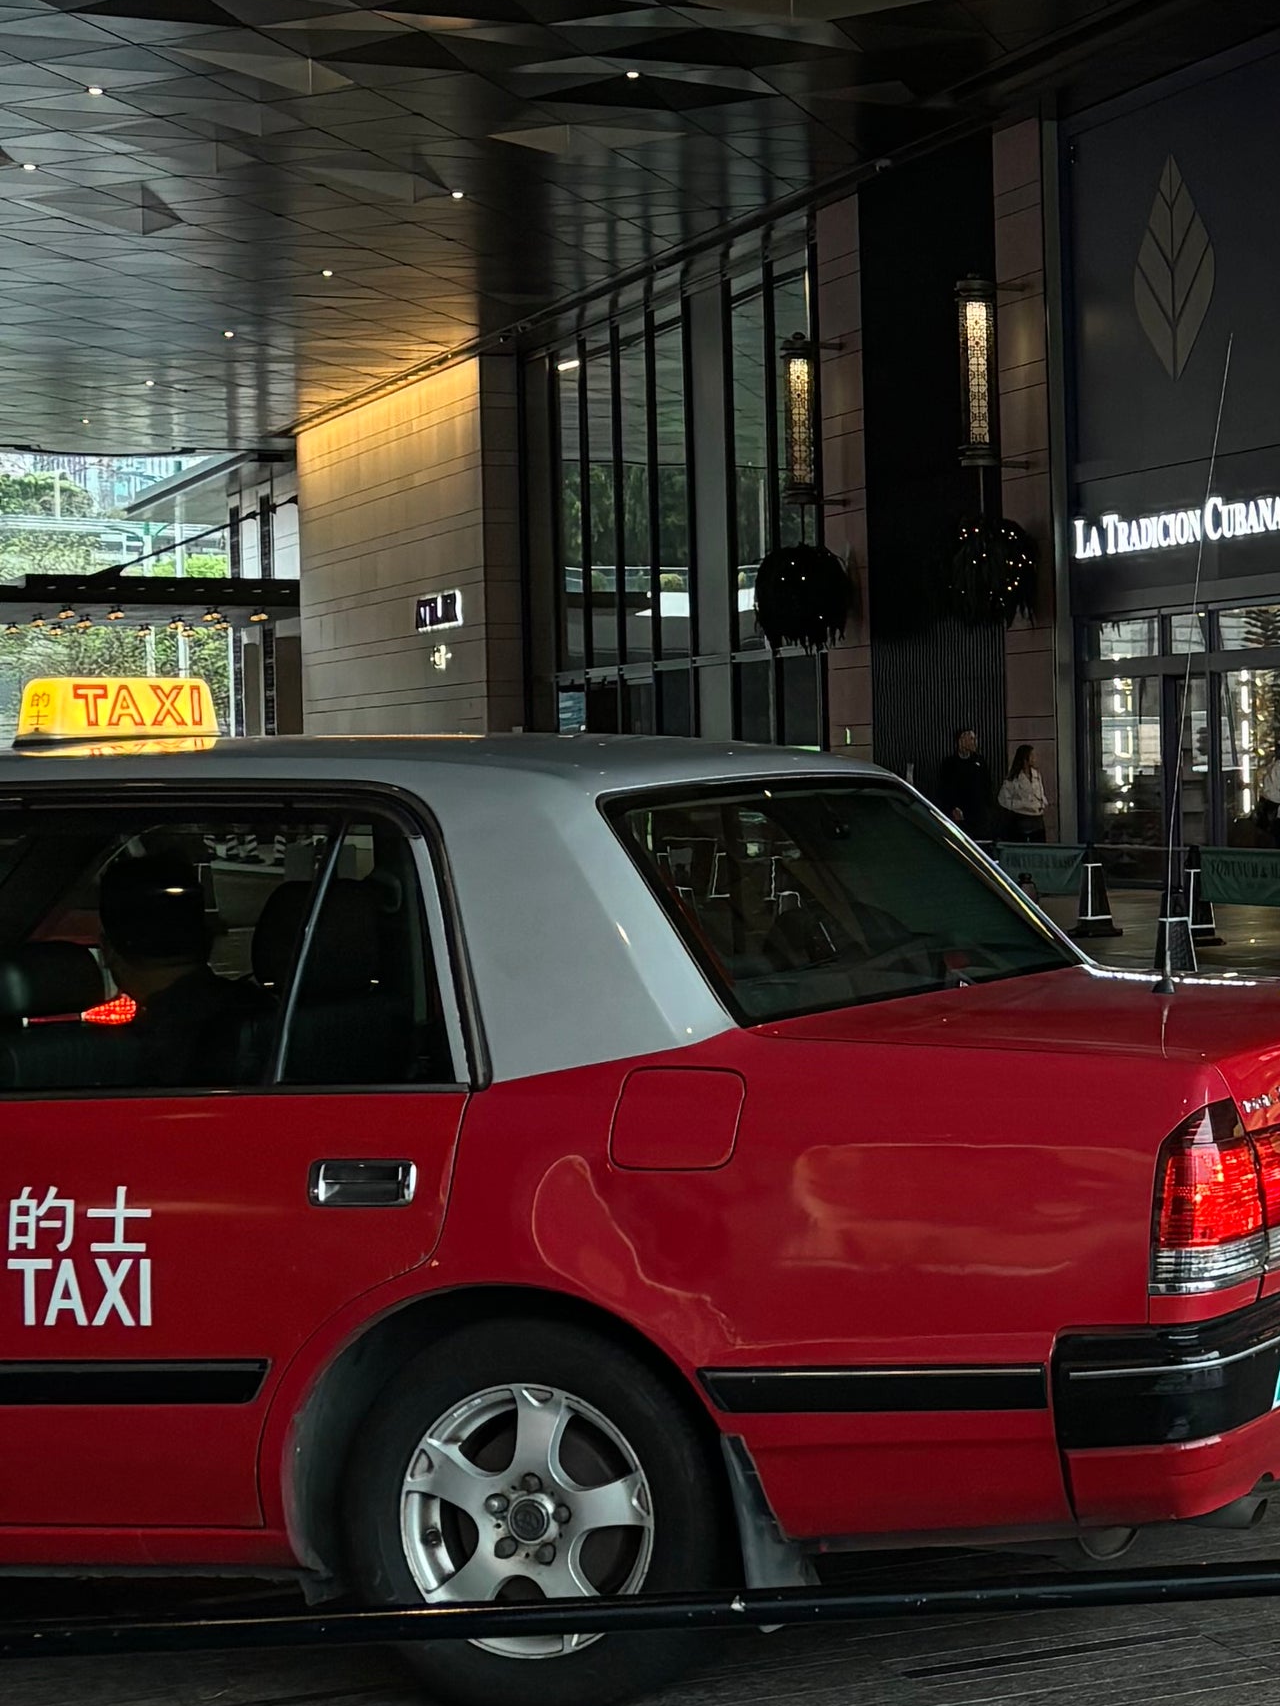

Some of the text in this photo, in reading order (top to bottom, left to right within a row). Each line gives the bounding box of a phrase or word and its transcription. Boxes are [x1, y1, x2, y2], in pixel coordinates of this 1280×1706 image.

[29, 692, 50, 726] 的士
[72, 684, 204, 727] TAXI
[8, 1185, 152, 1253] 的士
[7, 1258, 153, 1326] TAXI
